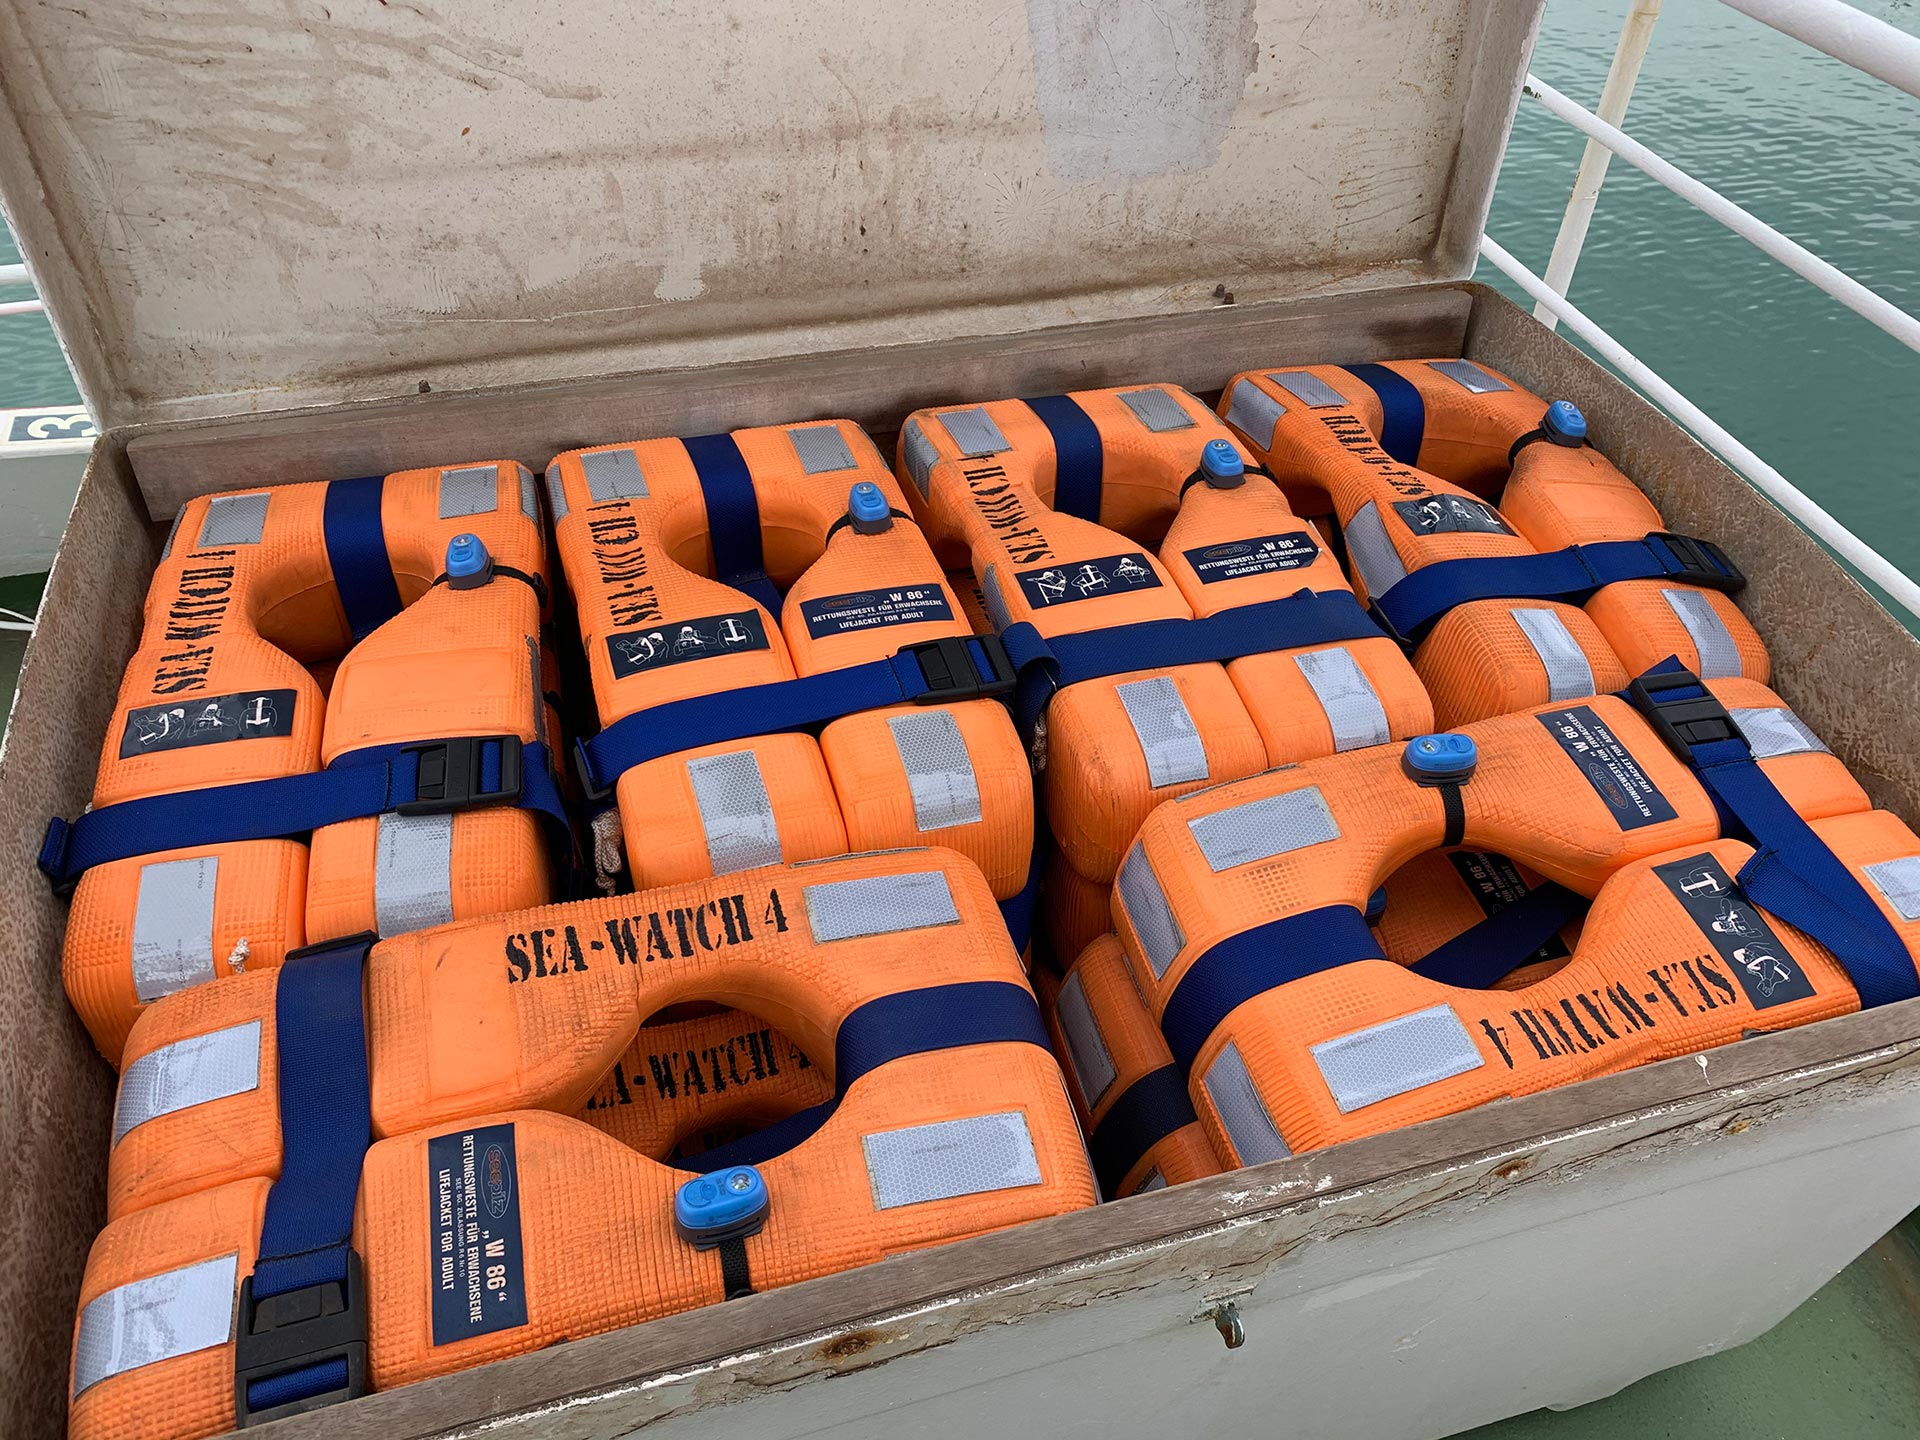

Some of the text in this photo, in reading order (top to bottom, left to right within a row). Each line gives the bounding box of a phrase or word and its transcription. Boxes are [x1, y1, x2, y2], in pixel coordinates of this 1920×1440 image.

[27, 414, 97, 438] 3
[813, 608, 876, 622] RETTUNGSWESTE
[895, 600, 942, 608] ERWACHSENE
[839, 617, 881, 628] LIFEJACKET
[1564, 712, 1599, 748] ERWACHSENE
[1594, 726, 1652, 792] LIFEJACKET FOR ADULT
[1607, 763, 1652, 817] RETTUNGSWESTE
[505, 889, 789, 984] SEA-WATCH 4
[587, 1029, 779, 1110] A-WATCH
[439, 1168, 455, 1290] LIFEJACKET FOR ADULT
[463, 1134, 482, 1323] RETTUNGSWESTE FÜR ERWACHSENE
